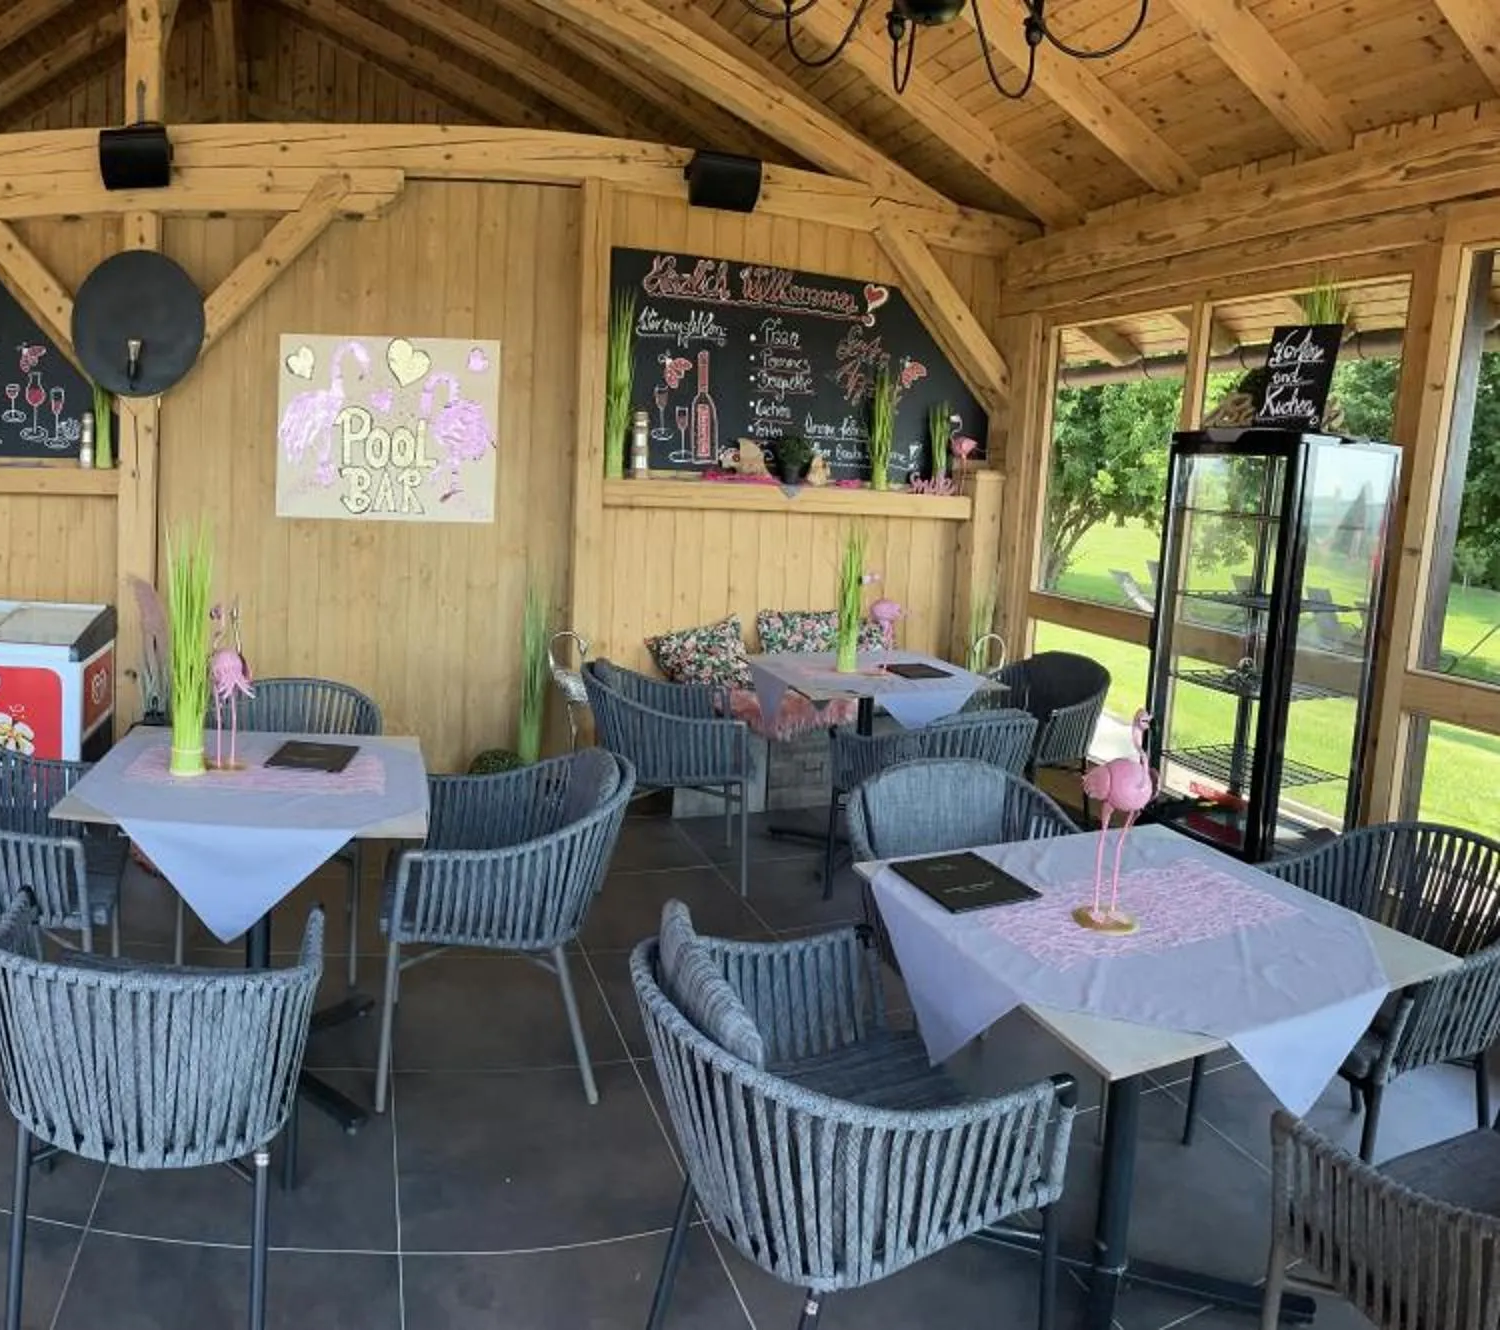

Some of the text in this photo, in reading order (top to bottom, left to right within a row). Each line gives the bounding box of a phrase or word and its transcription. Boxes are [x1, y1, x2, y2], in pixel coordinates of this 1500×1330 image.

[1271, 362, 1302, 384] und
[1260, 385, 1317, 418] Kuchen
[333, 404, 439, 470] POOL
[338, 466, 426, 515] BAR
